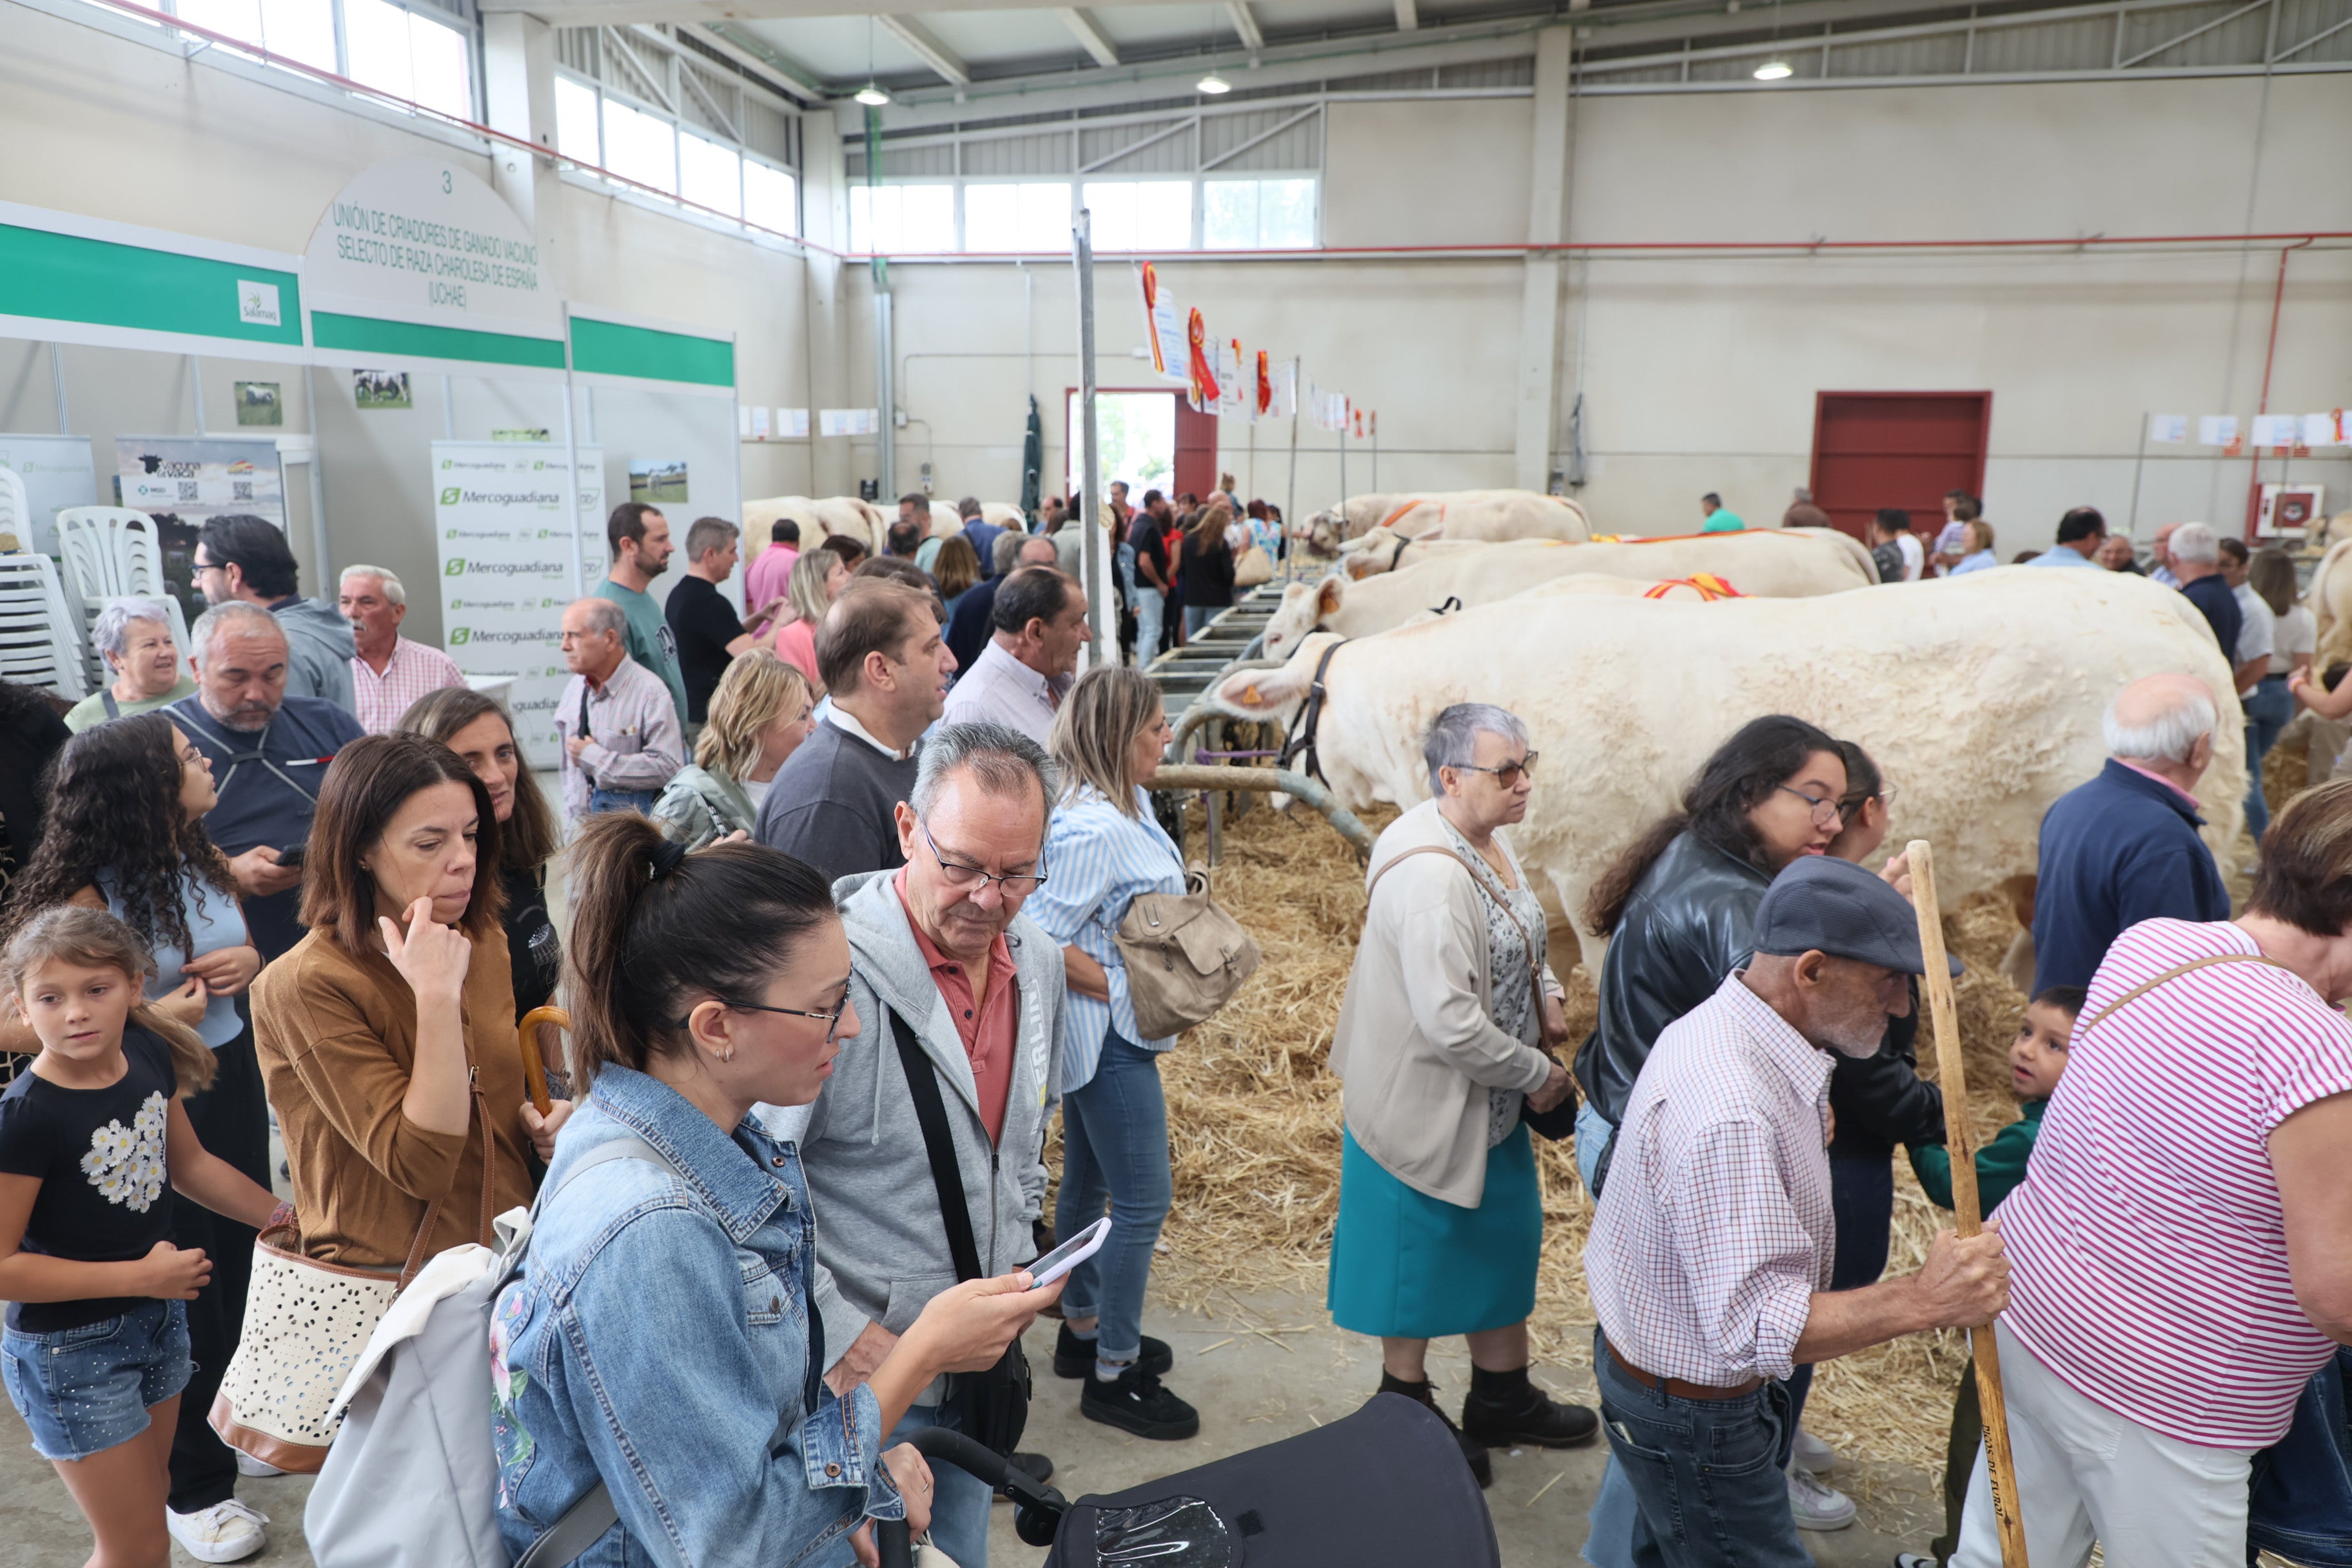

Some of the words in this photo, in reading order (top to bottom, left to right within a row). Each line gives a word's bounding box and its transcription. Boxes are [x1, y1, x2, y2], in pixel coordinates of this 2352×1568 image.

[442, 170, 453, 194] 3
[333, 201, 369, 232] UNIÓN
[372, 211, 387, 236] DE
[389, 213, 447, 248] CRIADORES
[449, 227, 462, 251] DE
[464, 230, 502, 259] GANADO
[504, 240, 538, 266] VACUNO
[337, 234, 387, 266] SELECTO
[390, 244, 404, 269] DE
[406, 248, 433, 273] RAZA
[435, 253, 489, 284] CHAROLESA
[493, 264, 504, 286] DE
[505, 266, 539, 291] ESPAÑA
[429, 281, 467, 311] (UCHAE)
[462, 490, 560, 507] Mercoguadiana
[467, 560, 564, 577] Mercoguadiana
[1982, 1424, 1994, 1456] PICOS
[1988, 1460, 1997, 1476] DE
